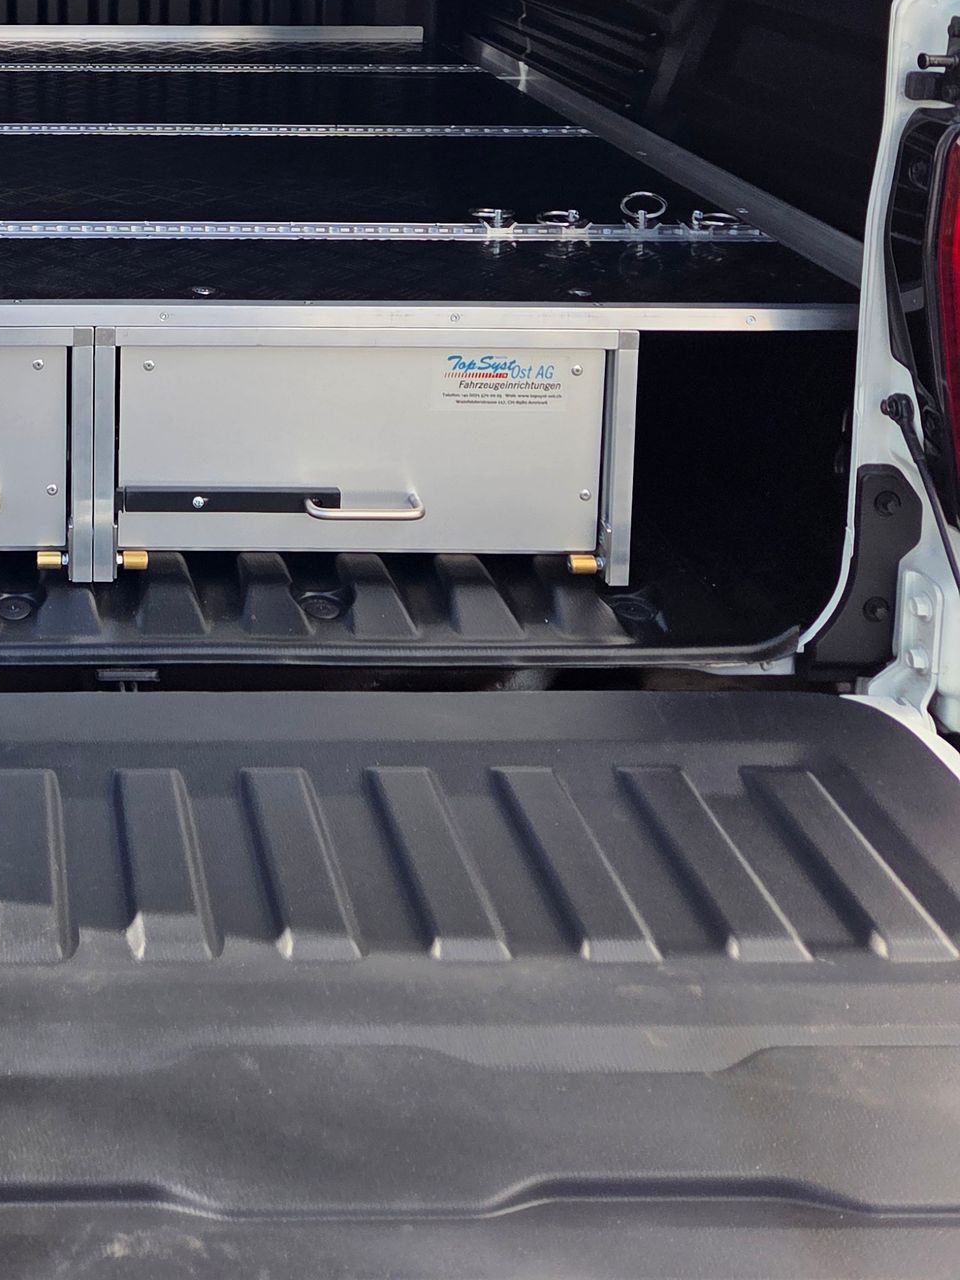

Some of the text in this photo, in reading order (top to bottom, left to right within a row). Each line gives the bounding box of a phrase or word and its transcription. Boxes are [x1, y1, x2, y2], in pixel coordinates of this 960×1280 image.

[511, 364, 554, 379] Ost AG
[458, 380, 561, 391] Fahrzeugeinrichtungen
